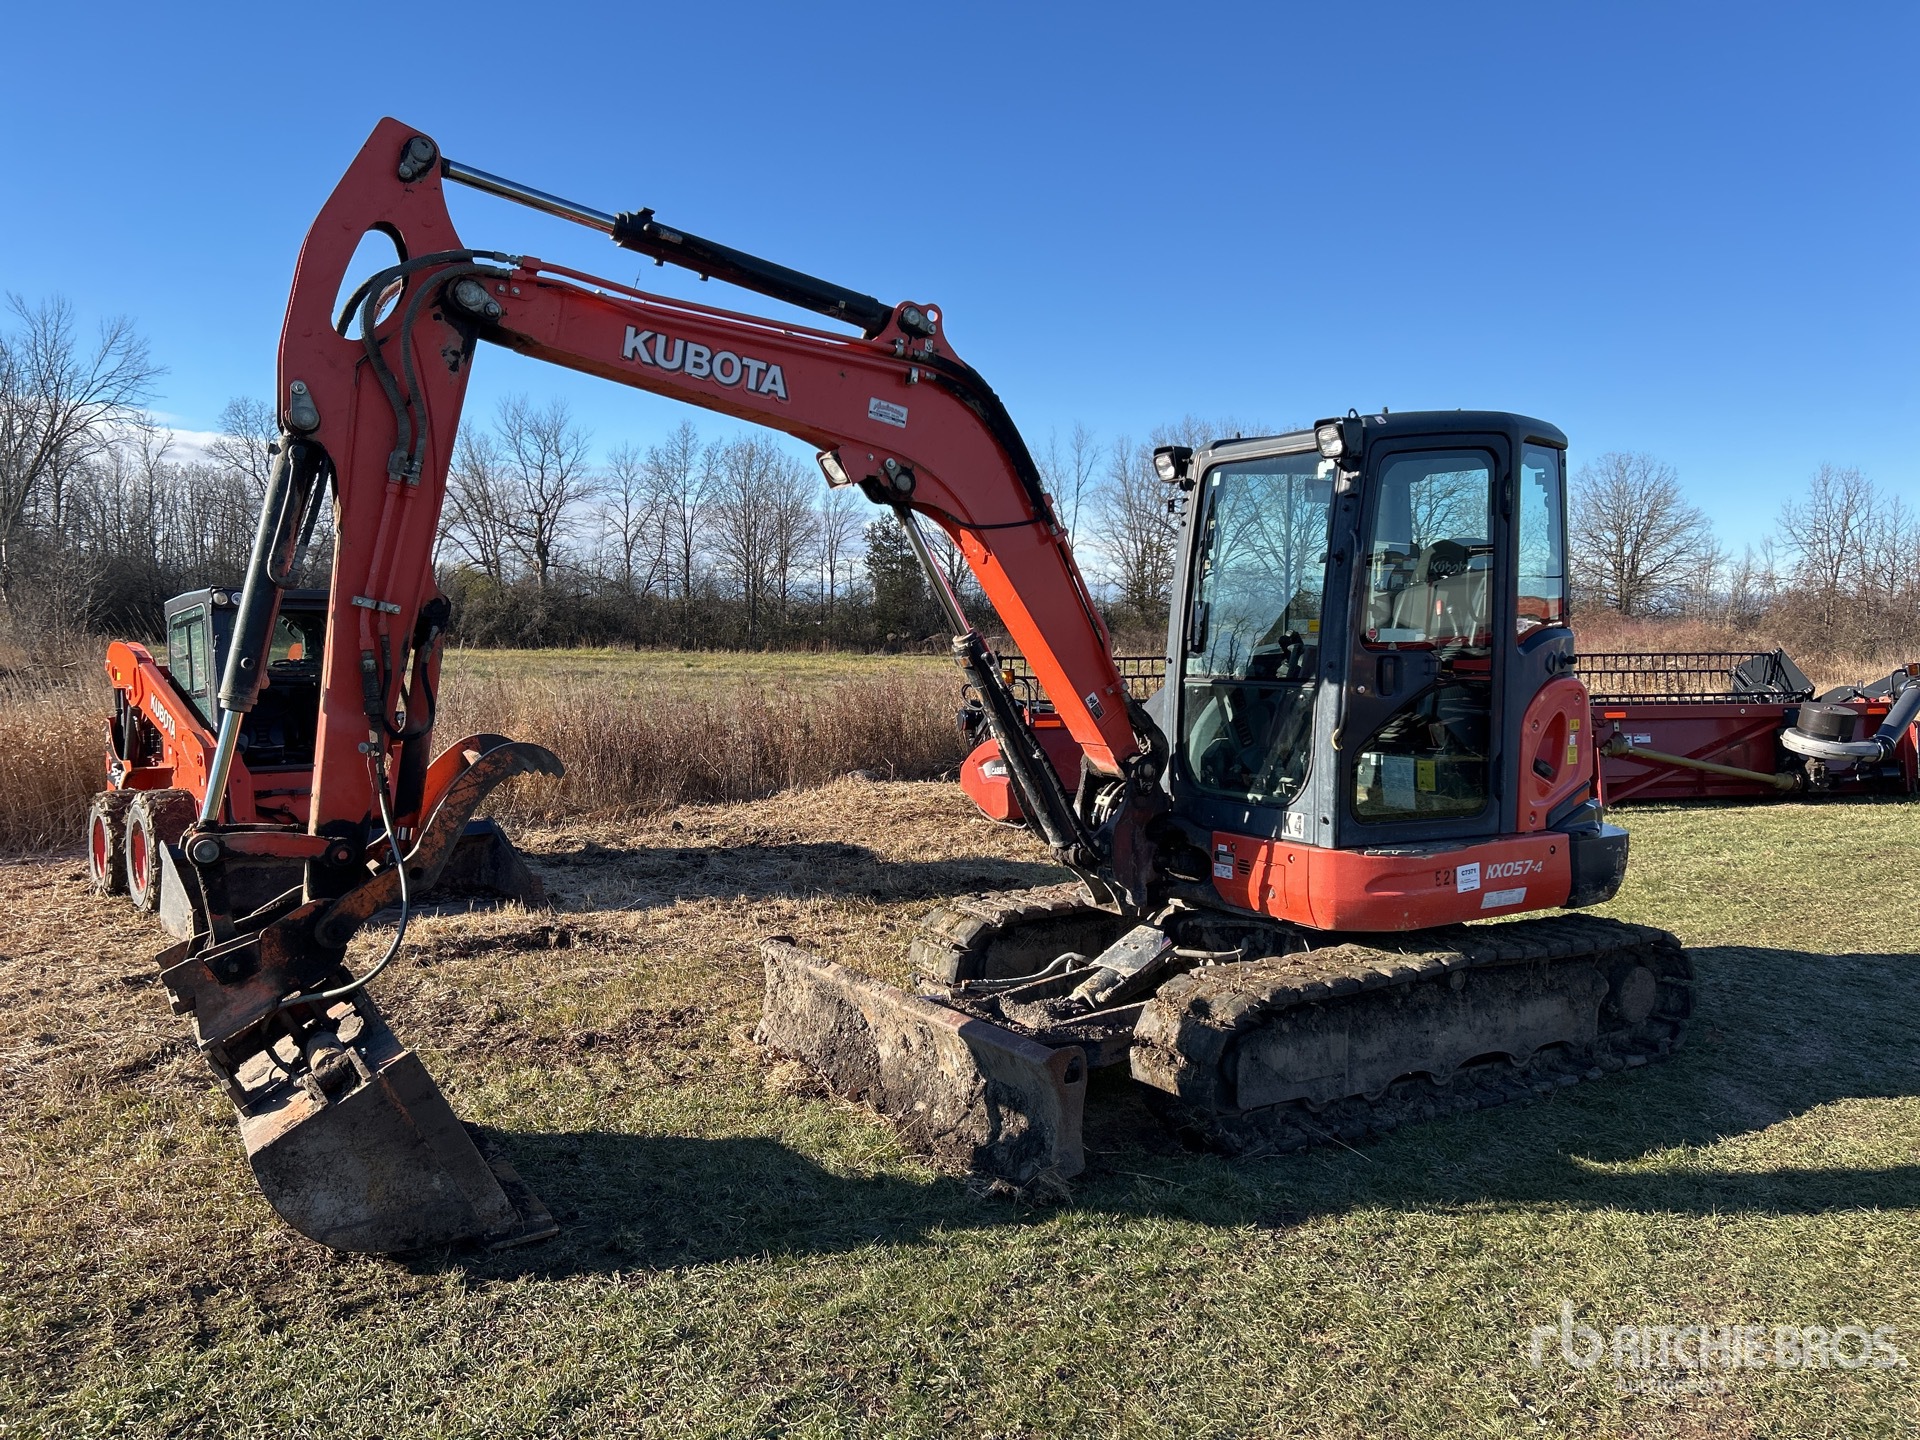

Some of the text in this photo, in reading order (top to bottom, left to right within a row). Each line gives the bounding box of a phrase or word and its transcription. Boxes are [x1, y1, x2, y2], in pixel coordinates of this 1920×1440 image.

[622, 325, 788, 399] KUBOTA
[150, 692, 176, 740] KUBOTA
[1485, 860, 1543, 879] KX057-4
